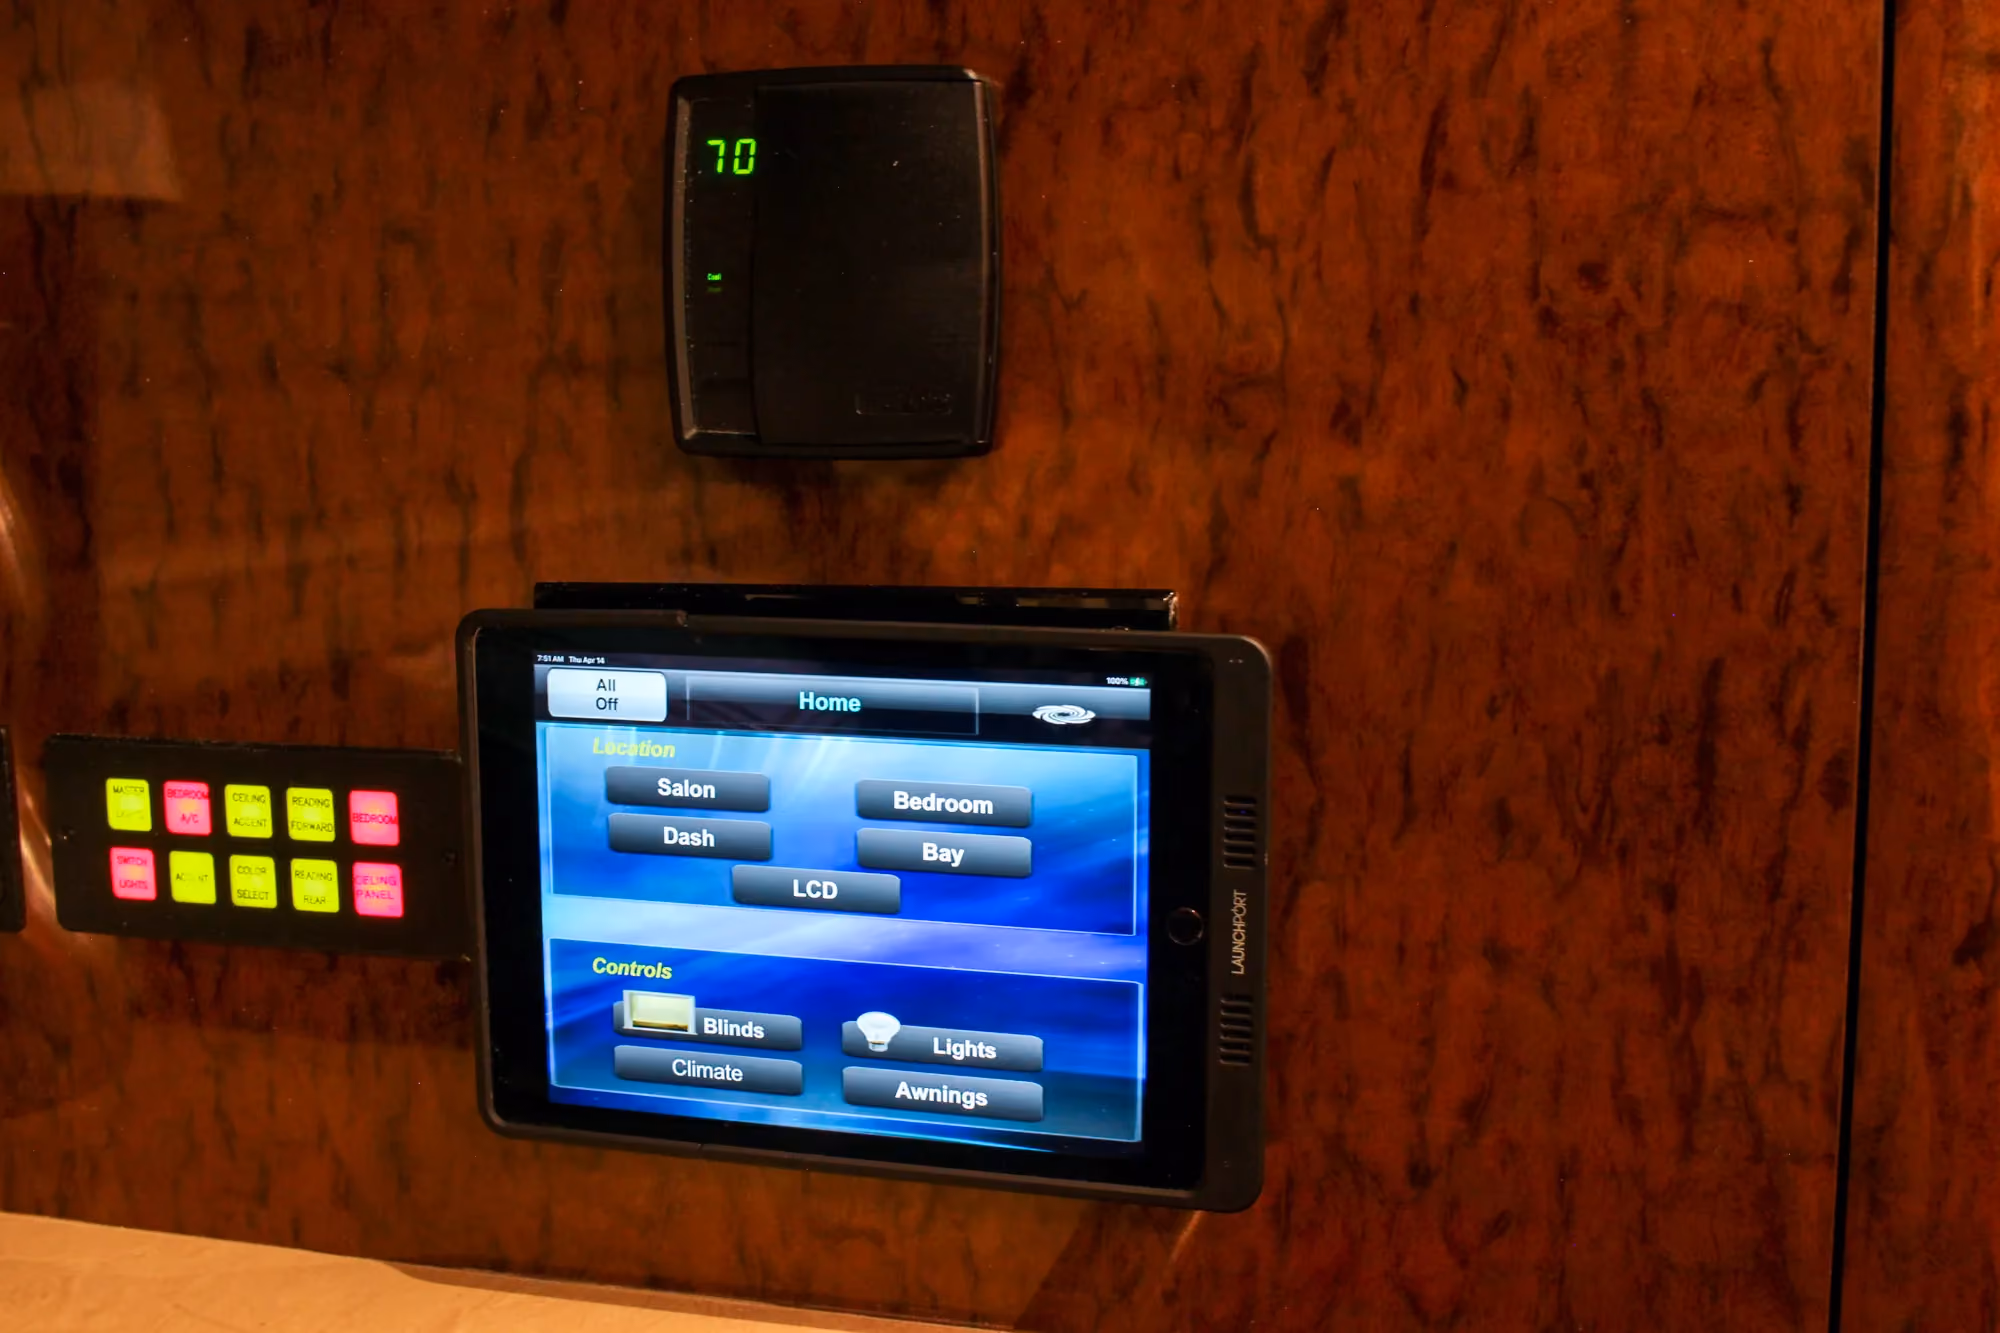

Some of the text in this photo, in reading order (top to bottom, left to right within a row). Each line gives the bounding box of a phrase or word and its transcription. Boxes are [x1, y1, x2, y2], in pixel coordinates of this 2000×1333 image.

[706, 138, 757, 175] 70
[552, 655, 565, 663] AM
[568, 656, 582, 664] Thu
[582, 657, 595, 665] Apr
[596, 678, 616, 692] All
[1106, 677, 1128, 685] 100%
[596, 697, 619, 711] Off
[799, 692, 861, 712] Home
[593, 737, 675, 758] Location
[167, 788, 209, 799] BEDROOM
[657, 777, 716, 799] Salon
[232, 793, 266, 804] CEILING
[292, 796, 331, 808] READING
[893, 791, 994, 815] Bedroom
[180, 813, 200, 824] A/C
[233, 818, 267, 828] ACCENT
[352, 812, 398, 824] BEDROOM
[291, 821, 334, 832] FORWARD
[663, 826, 715, 848] Dash
[116, 855, 148, 866] SWITCH
[922, 842, 964, 867] Bay
[236, 865, 266, 875] COLOR
[294, 870, 333, 881] READING
[236, 889, 269, 900] SELECT
[356, 890, 394, 900] PANEL
[793, 879, 838, 900] LCD
[303, 895, 327, 905] REAR
[1230, 889, 1249, 975] LAUNCHPORT
[592, 956, 673, 980] Controls
[703, 1017, 765, 1040] Blinds
[933, 1036, 998, 1061] Lights
[672, 1058, 744, 1082] Climate
[895, 1081, 989, 1109] Awnings
